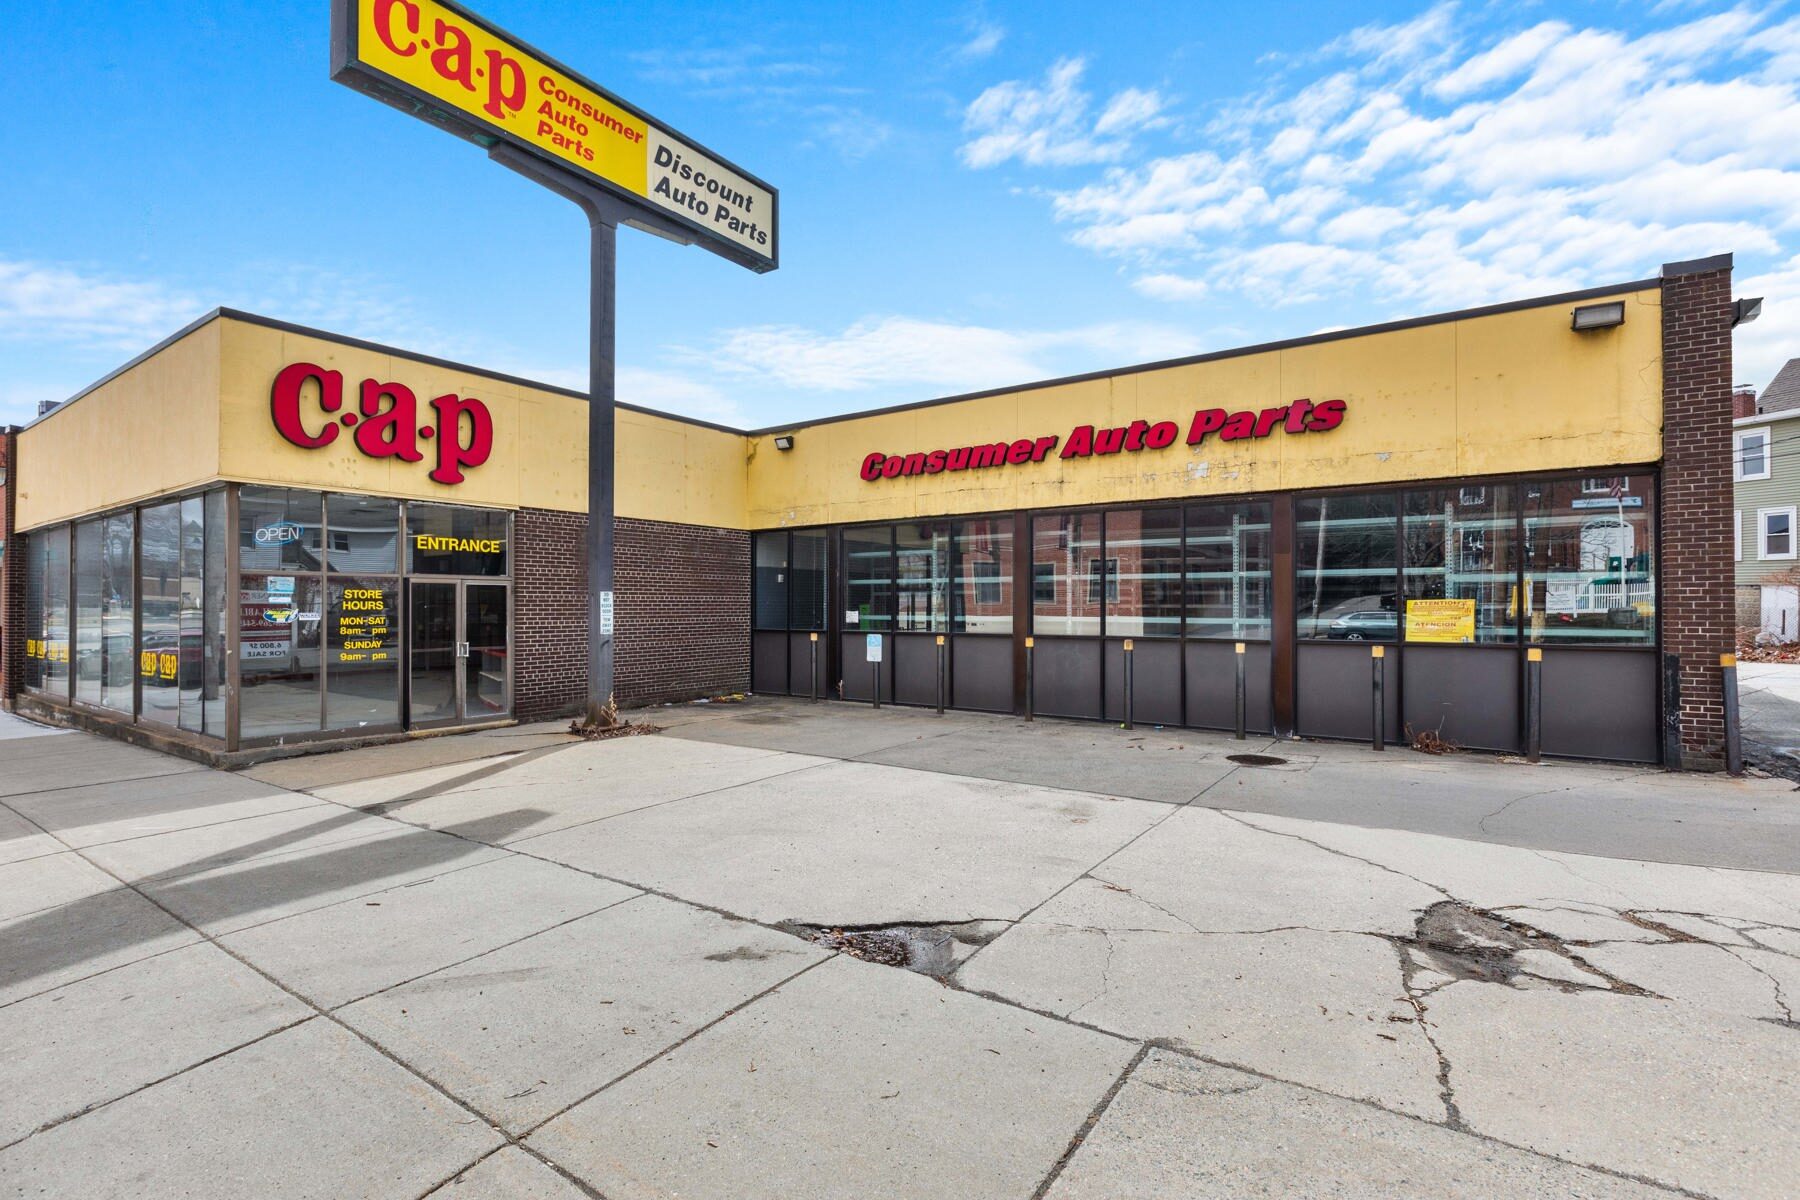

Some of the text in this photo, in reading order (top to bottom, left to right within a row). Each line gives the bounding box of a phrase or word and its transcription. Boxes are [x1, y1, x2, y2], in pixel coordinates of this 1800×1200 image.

[538, 75, 644, 145] Consumer
[537, 102, 589, 137] Auto
[537, 123, 595, 162] Parts
[653, 145, 754, 213] Discount
[653, 176, 768, 246] Auto Parts
[860, 398, 1348, 482] Consumer Auto Parts
[255, 526, 299, 543] OPEN
[416, 535, 500, 554] ENTRANCE
[343, 589, 383, 599] STORE
[342, 601, 384, 611] HOURS
[339, 616, 386, 626] MON-SAT
[339, 626, 387, 636] 8am- pm
[343, 640, 383, 650] SUNDAY
[339, 652, 387, 661] 9am- pm
